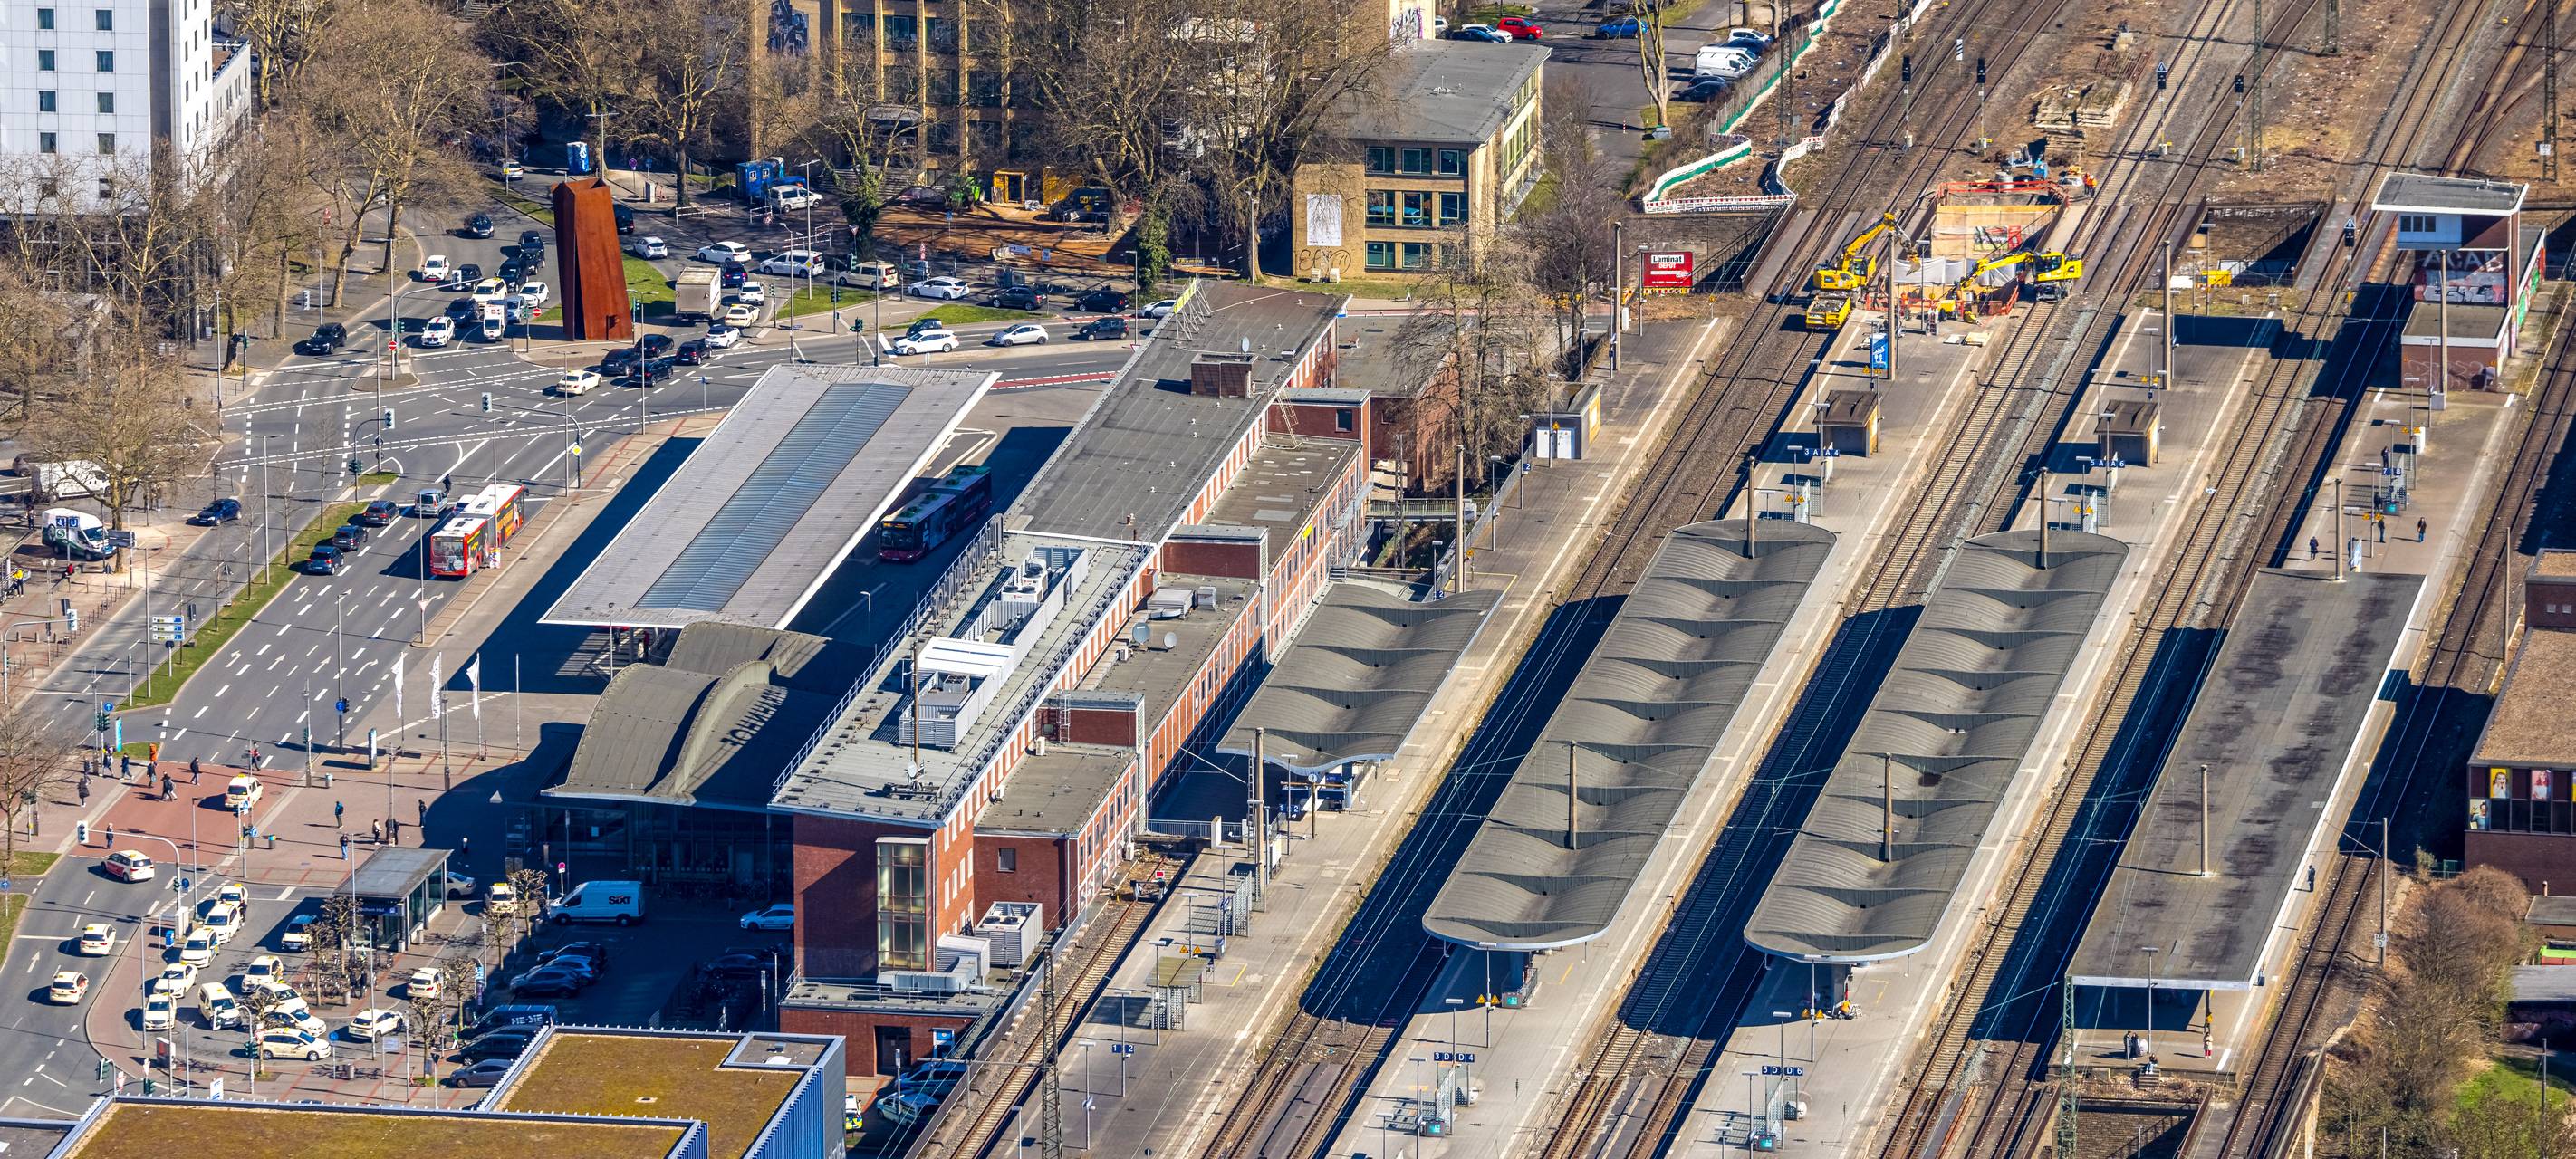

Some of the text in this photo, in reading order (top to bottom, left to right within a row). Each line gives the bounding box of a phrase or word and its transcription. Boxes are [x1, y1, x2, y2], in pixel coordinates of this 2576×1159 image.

[70, 518, 76, 526] U
[608, 895, 631, 905] SIXT
[1772, 1066, 1778, 1074] D
[1796, 1067, 1802, 1075] 6
